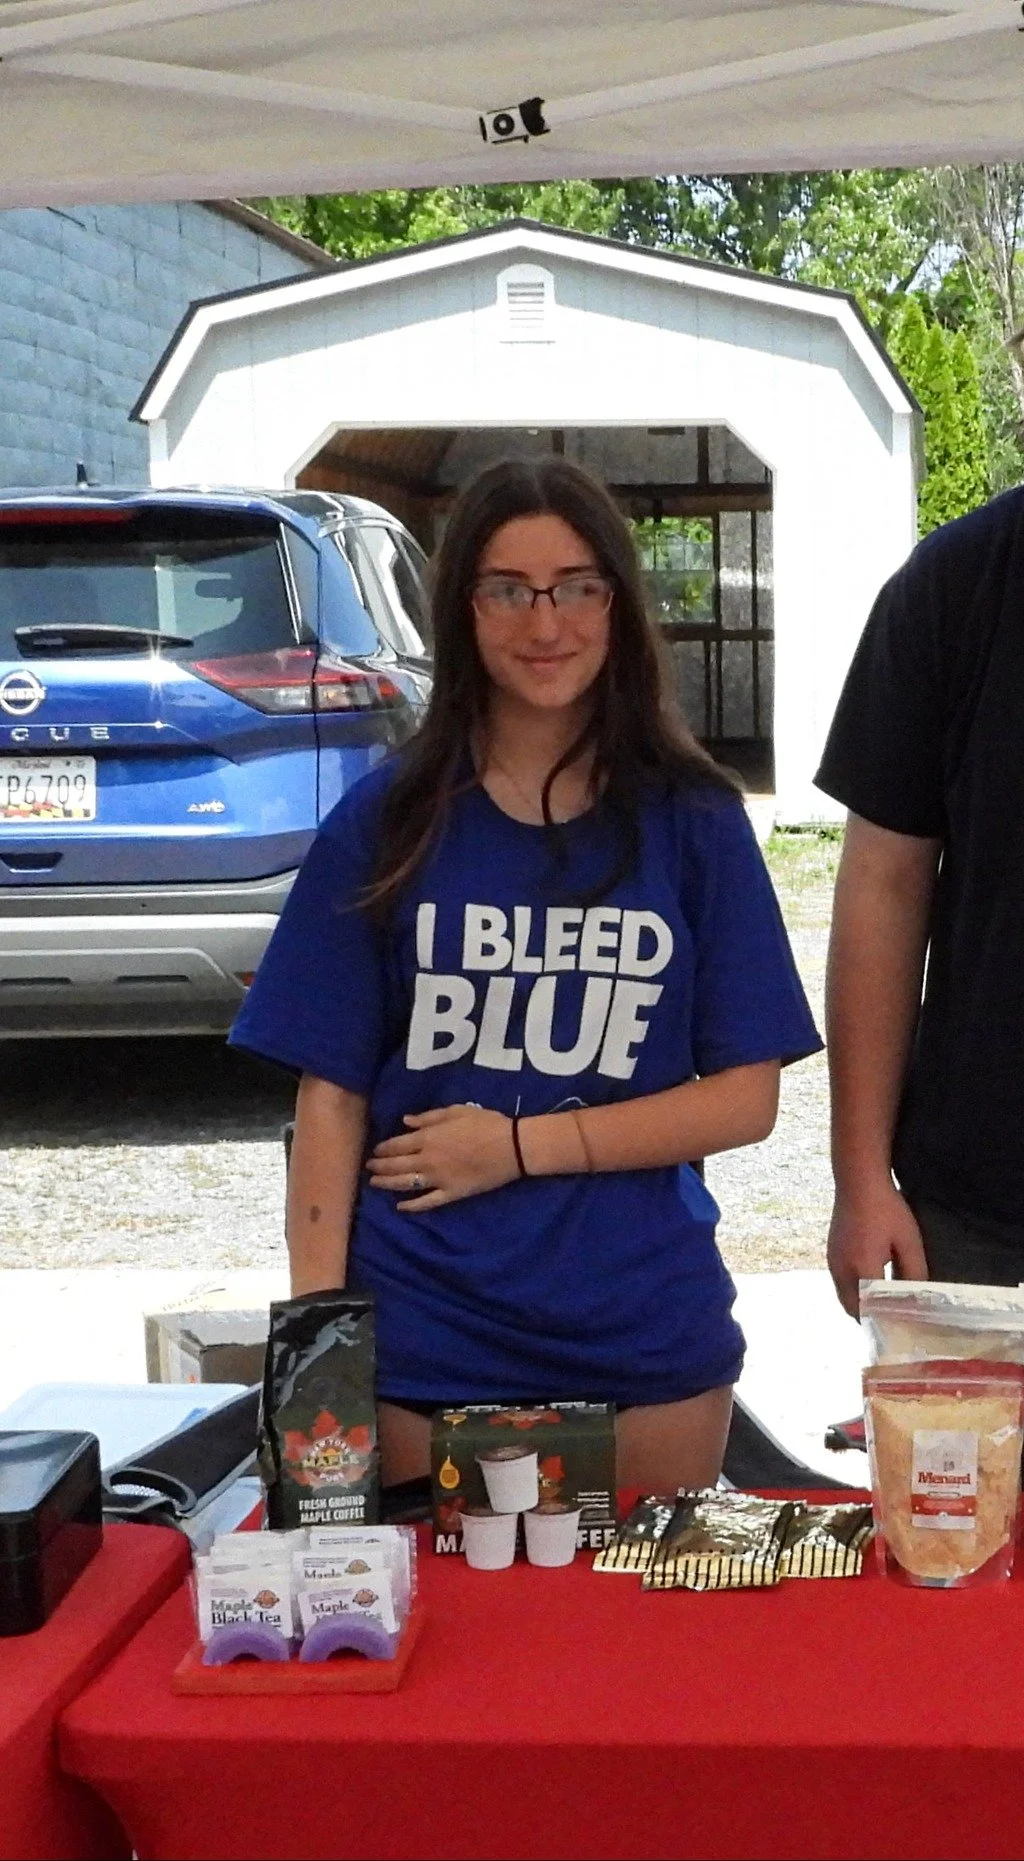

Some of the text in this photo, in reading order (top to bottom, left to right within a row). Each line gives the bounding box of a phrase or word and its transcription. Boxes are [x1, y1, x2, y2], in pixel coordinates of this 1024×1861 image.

[0, 774, 87, 807] P6709
[416, 903, 674, 977] I BLEED
[406, 972, 664, 1080] BLUE
[918, 1471, 971, 1485] Menard
[299, 1495, 365, 1511] FRESH GROUND
[301, 1509, 331, 1523] MAPLE
[211, 1599, 253, 1615] Maple
[311, 1600, 350, 1615] Maple
[211, 1610, 281, 1625] Black Tea
